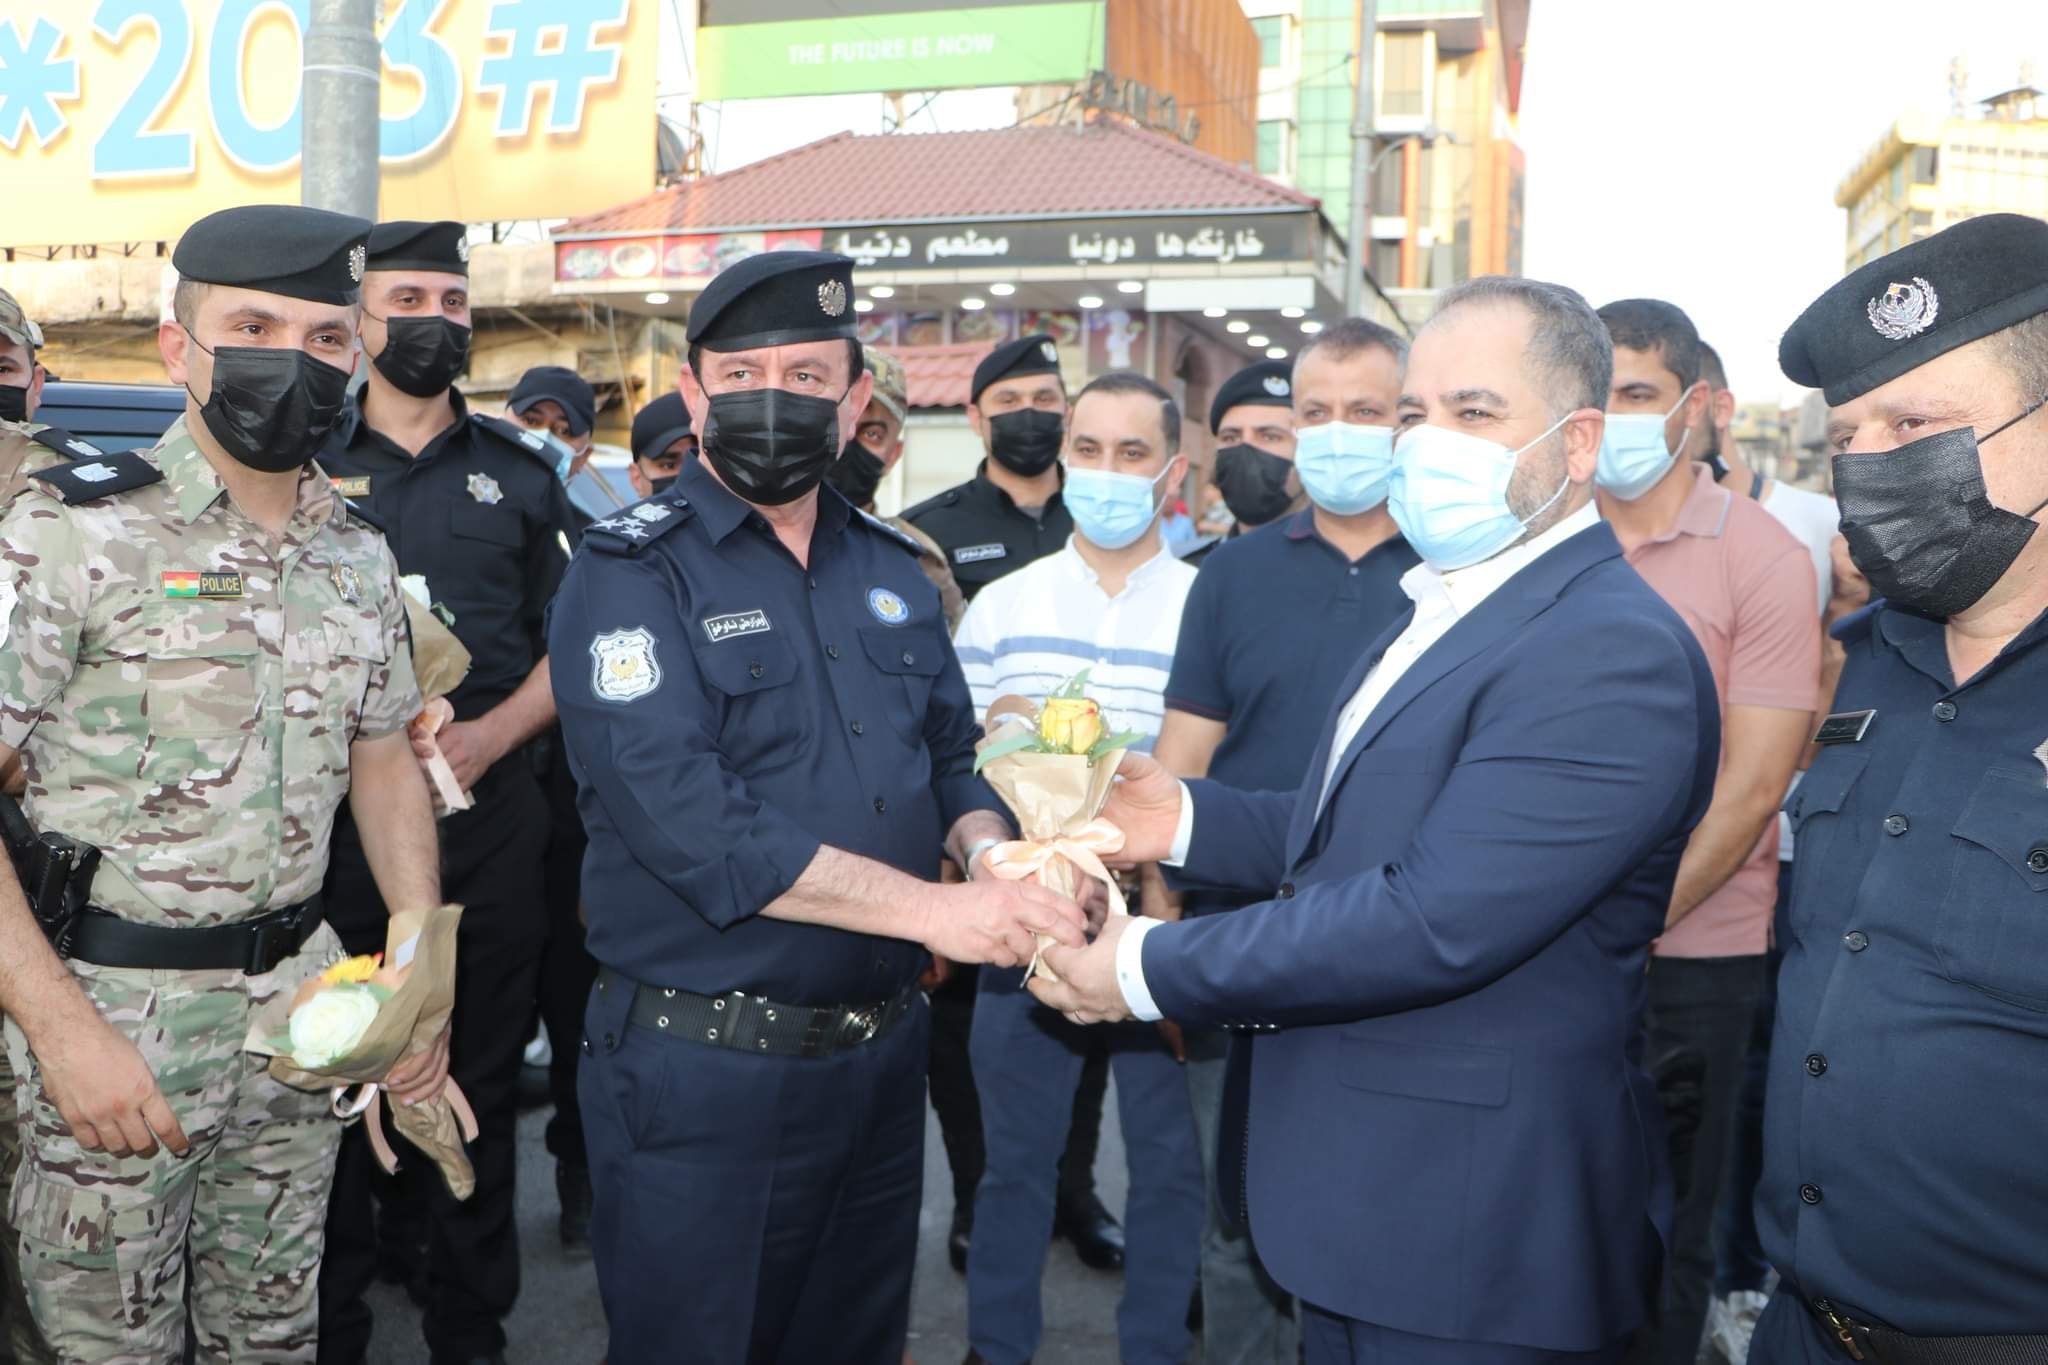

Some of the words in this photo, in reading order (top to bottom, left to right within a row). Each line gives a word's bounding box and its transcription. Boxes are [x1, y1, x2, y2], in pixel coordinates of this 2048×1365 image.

[788, 45, 824, 65] THE
[831, 38, 906, 63] FUTURE
[911, 36, 929, 58] IS
[937, 33, 996, 56] NOW
[926, 229, 1009, 264] مطعم
[201, 576, 240, 592] POLICE
